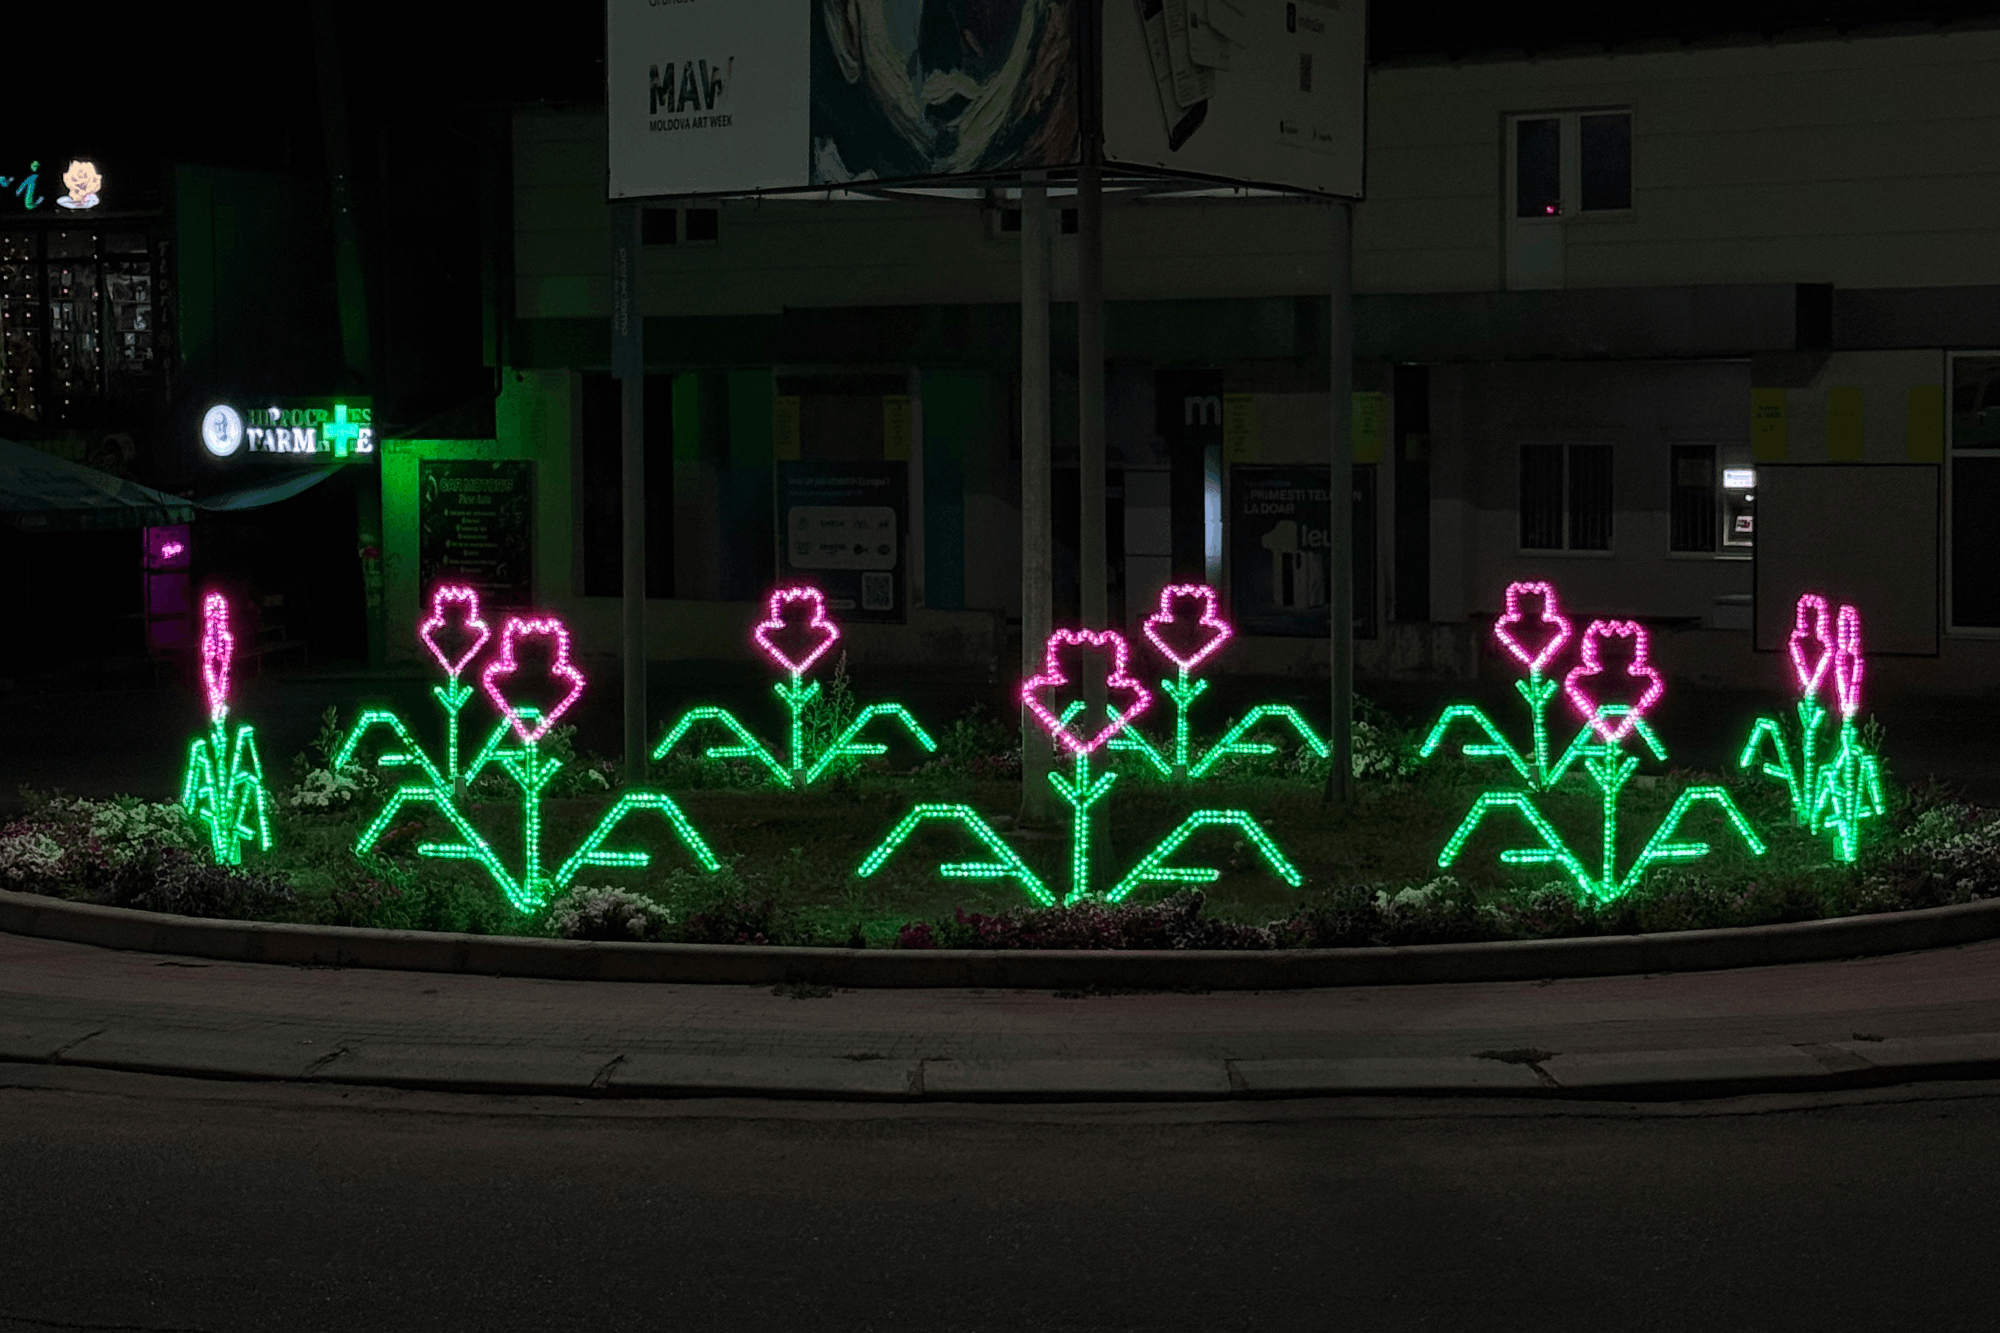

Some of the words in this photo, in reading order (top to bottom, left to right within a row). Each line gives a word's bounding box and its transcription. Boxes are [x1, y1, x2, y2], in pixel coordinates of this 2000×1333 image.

[649, 118, 690, 132] MOLDOVA
[692, 116, 708, 129] ART
[709, 114, 733, 128] WEEK
[1243, 503, 1259, 514] LA
[1260, 503, 1296, 515] DOAR
